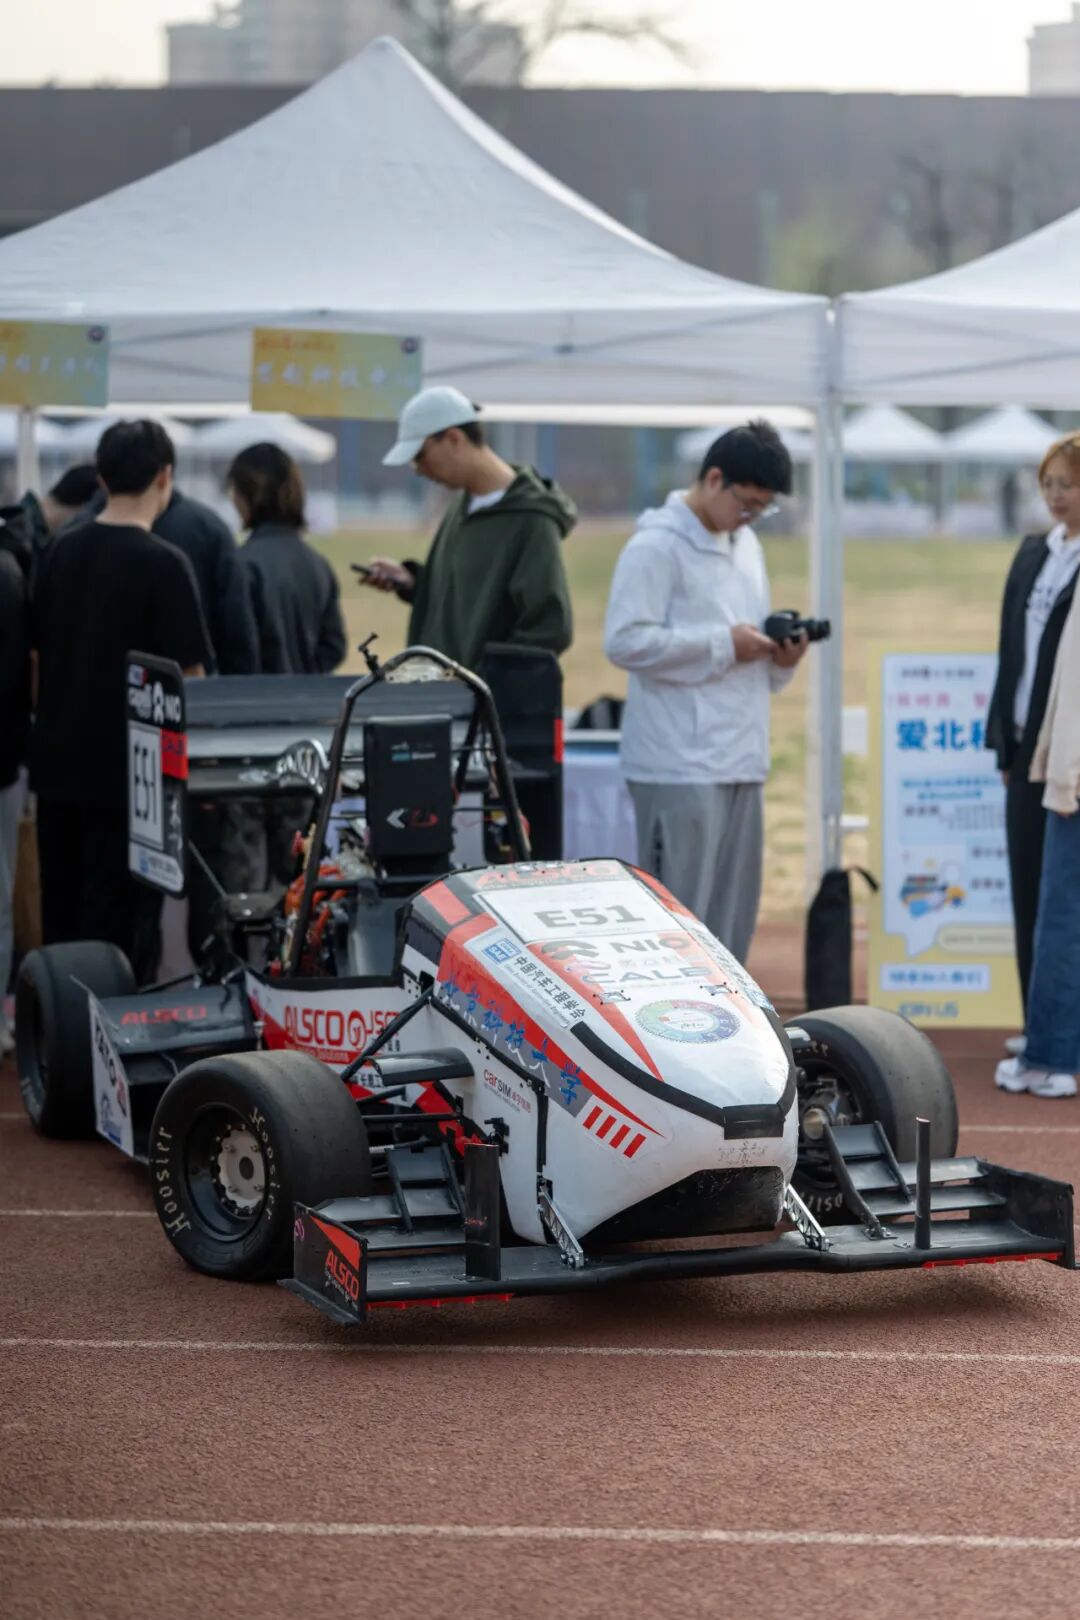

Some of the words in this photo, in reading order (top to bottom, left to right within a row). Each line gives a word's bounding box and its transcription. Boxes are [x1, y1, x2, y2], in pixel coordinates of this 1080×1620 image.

[534, 905, 645, 928] E51
[610, 937, 690, 953] NIO
[513, 956, 586, 1019] 中国汽车工程学会
[582, 966, 712, 984] CALB
[120, 1005, 207, 1025] ALSCO
[285, 1006, 345, 1046] ALSCO
[155, 1126, 192, 1237] Hoosier
[325, 1249, 359, 1301] ALSCO
